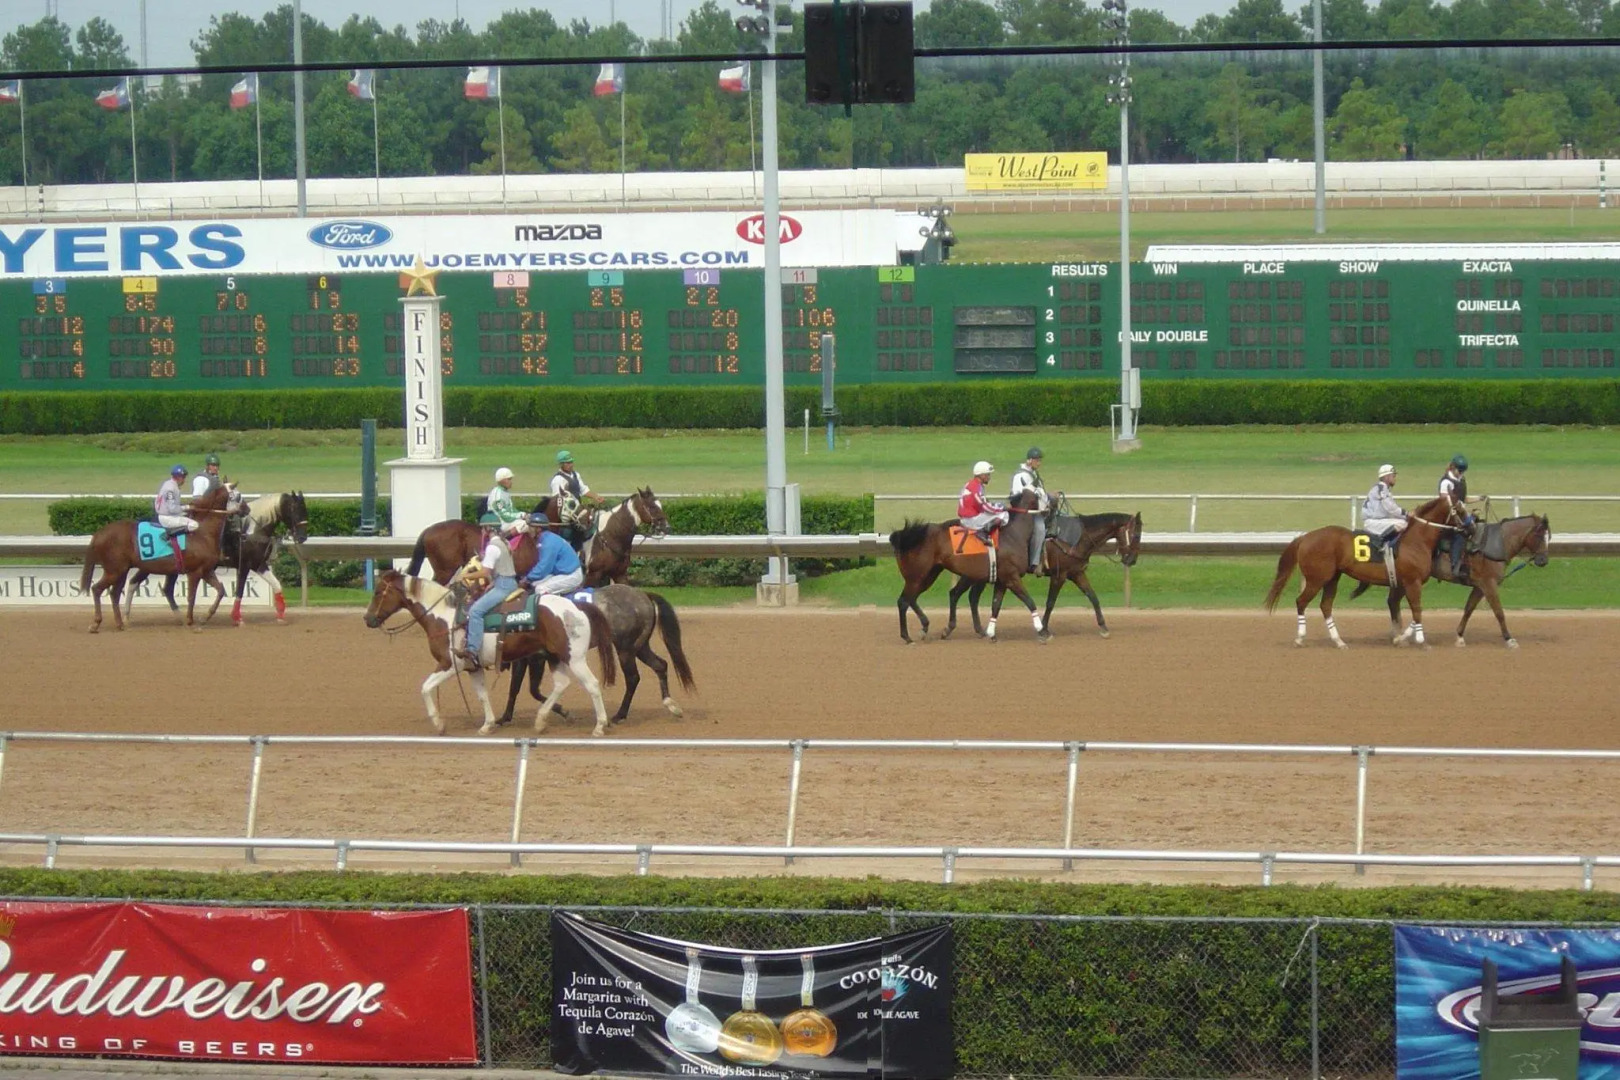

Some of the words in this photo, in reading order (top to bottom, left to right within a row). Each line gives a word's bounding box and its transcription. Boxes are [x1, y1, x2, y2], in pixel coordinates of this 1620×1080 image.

[324, 223, 376, 245] Ford
[746, 219, 794, 239] KA
[1052, 264, 1108, 276] RESULTS
[1153, 263, 1177, 274] WIN
[1244, 262, 1285, 274] PLACE
[1339, 262, 1379, 273] SHOW
[1463, 261, 1513, 273] EXACTA
[507, 273, 515, 286] 8
[602, 273, 610, 285] 9
[694, 271, 709, 283] 10
[793, 270, 805, 282] 11
[889, 269, 903, 281] 12
[45, 280, 54, 293] 3
[136, 279, 144, 291] 4
[226, 277, 236, 290] 5
[319, 276, 327, 289] 6
[804, 285, 816, 303] 3
[1047, 286, 1054, 297] 1
[1457, 300, 1521, 312] QUINELLA
[711, 309, 738, 327] 20
[799, 307, 835, 326] 106
[1046, 309, 1054, 320] 2
[63, 316, 83, 335] 12
[621, 332, 642, 351] 12
[1046, 332, 1055, 343] 3
[1156, 330, 1208, 342] DOUBLE
[1459, 334, 1519, 346] TRIFECTA
[338, 335, 359, 353] 14
[522, 356, 548, 375] 42
[617, 356, 641, 373] 21
[717, 355, 738, 373] 12
[1046, 354, 1056, 366] 4
[73, 361, 85, 378] 4
[150, 360, 175, 377] 20
[246, 359, 265, 376] 11
[413, 312, 429, 446] FINISH
[140, 533, 155, 558] 9
[953, 529, 969, 554] 7
[1354, 535, 1371, 562] 6
[571, 971, 596, 986] Join
[600, 977, 612, 986] us
[615, 976, 632, 989] for
[635, 981, 642, 990] a
[563, 987, 621, 1004] Margarita
[624, 993, 648, 1007] with
[558, 1003, 601, 1020] Tequila
[604, 1006, 655, 1022] Corazón
[894, 1010, 920, 1019] AGAVE
[578, 1021, 593, 1034] de
[596, 1022, 634, 1038] Agave!
[104, 1038, 148, 1049] OF
[681, 1063, 698, 1074] The
